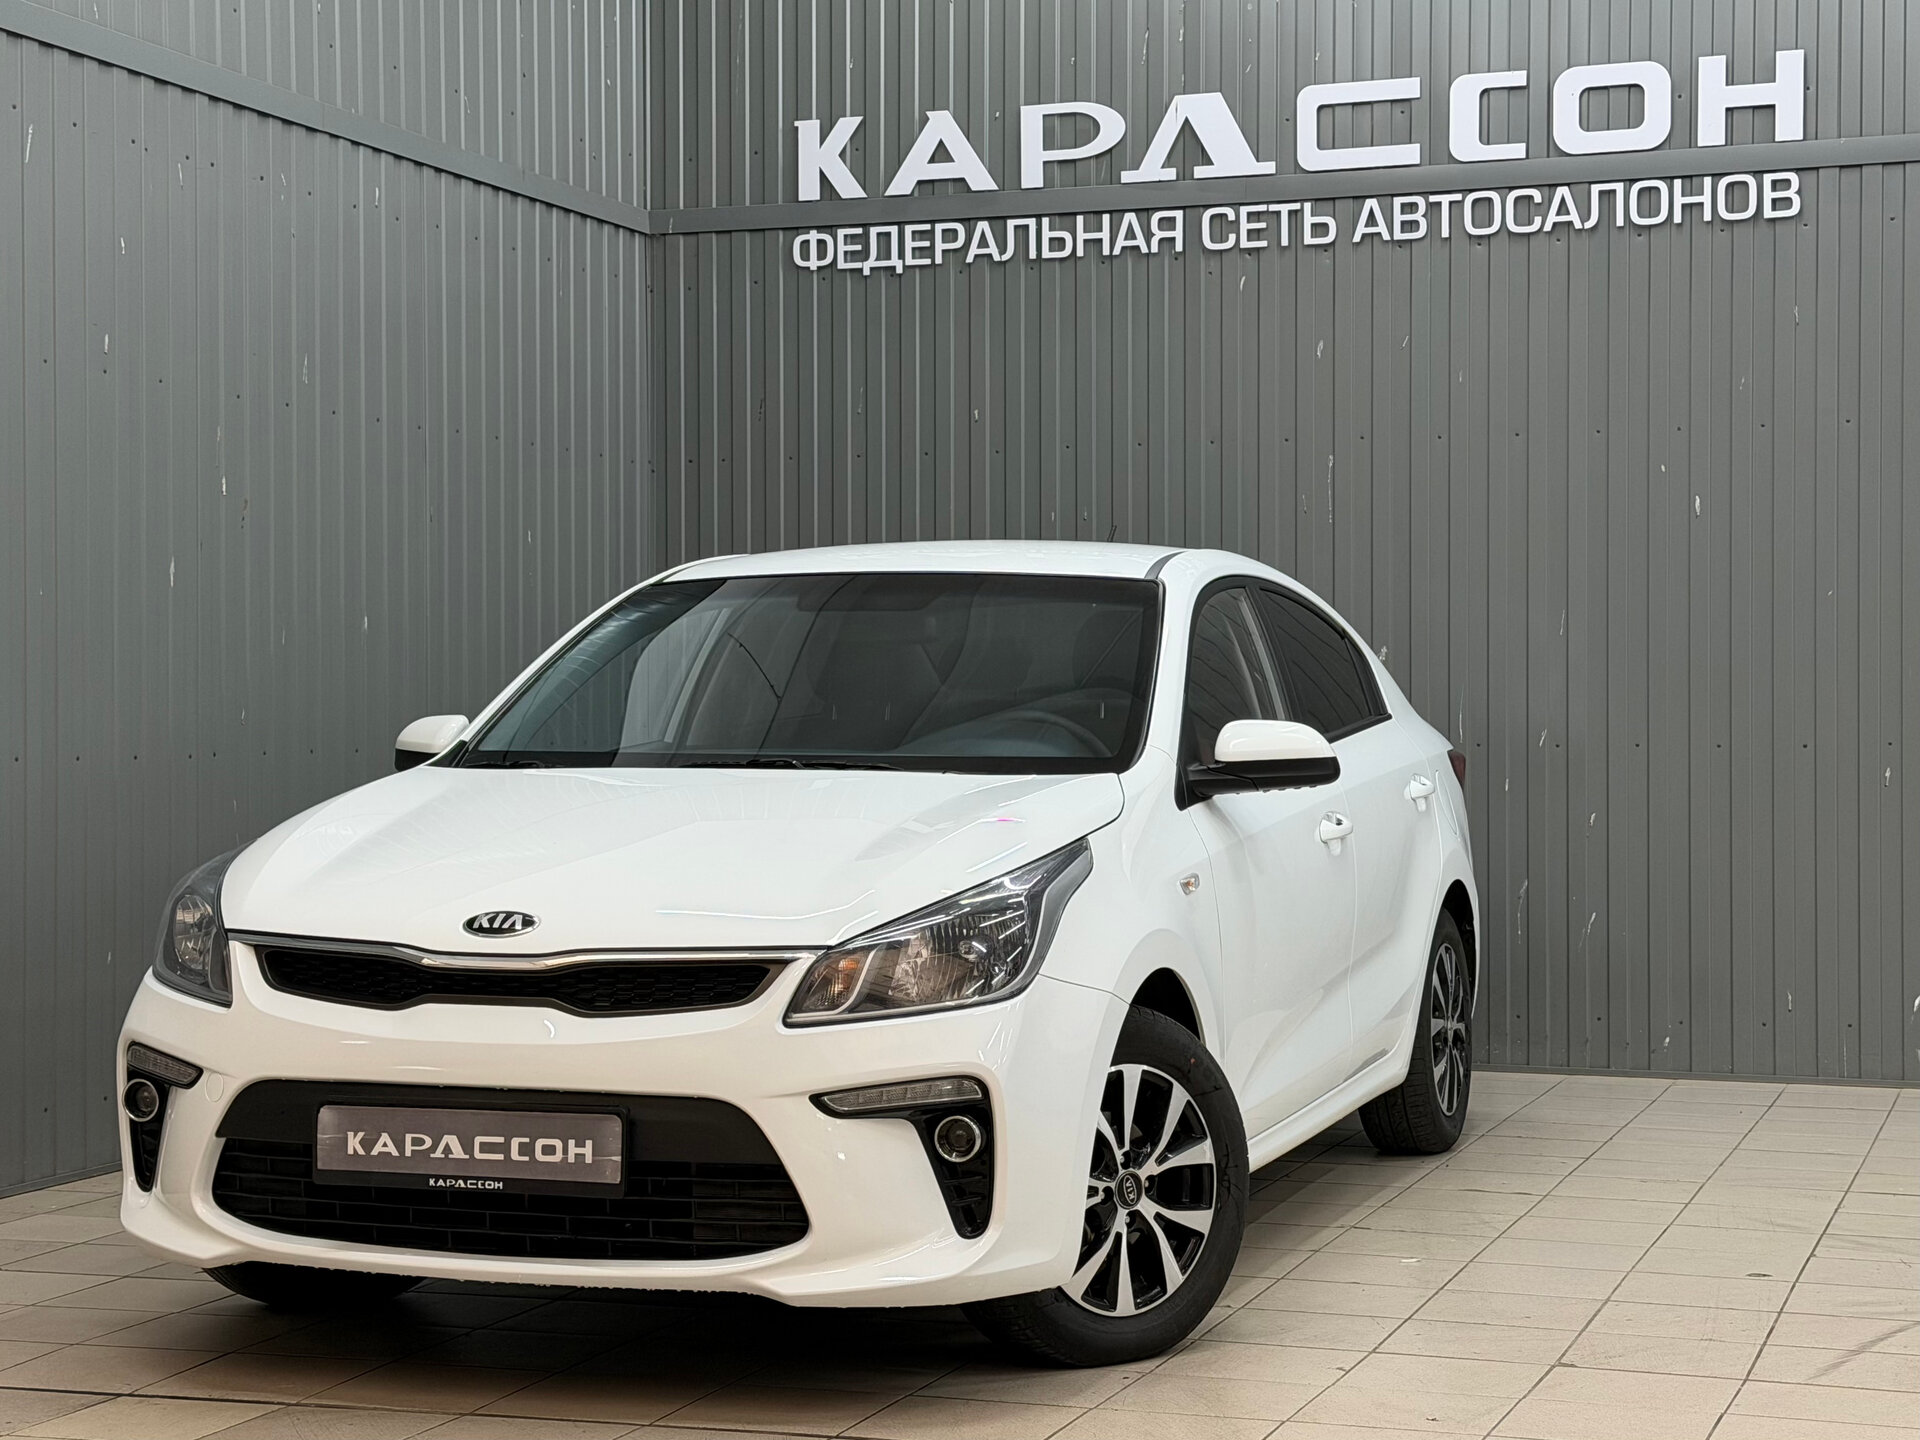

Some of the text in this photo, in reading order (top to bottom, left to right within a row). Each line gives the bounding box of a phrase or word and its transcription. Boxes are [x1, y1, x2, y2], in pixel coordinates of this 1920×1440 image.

[792, 171, 1801, 276] ФЕДЕРАЛЬНАЯ СЕТЬ АВТОСАЛОНОВ
[472, 913, 523, 930] KIA
[1125, 1180, 1136, 1200] KIA
